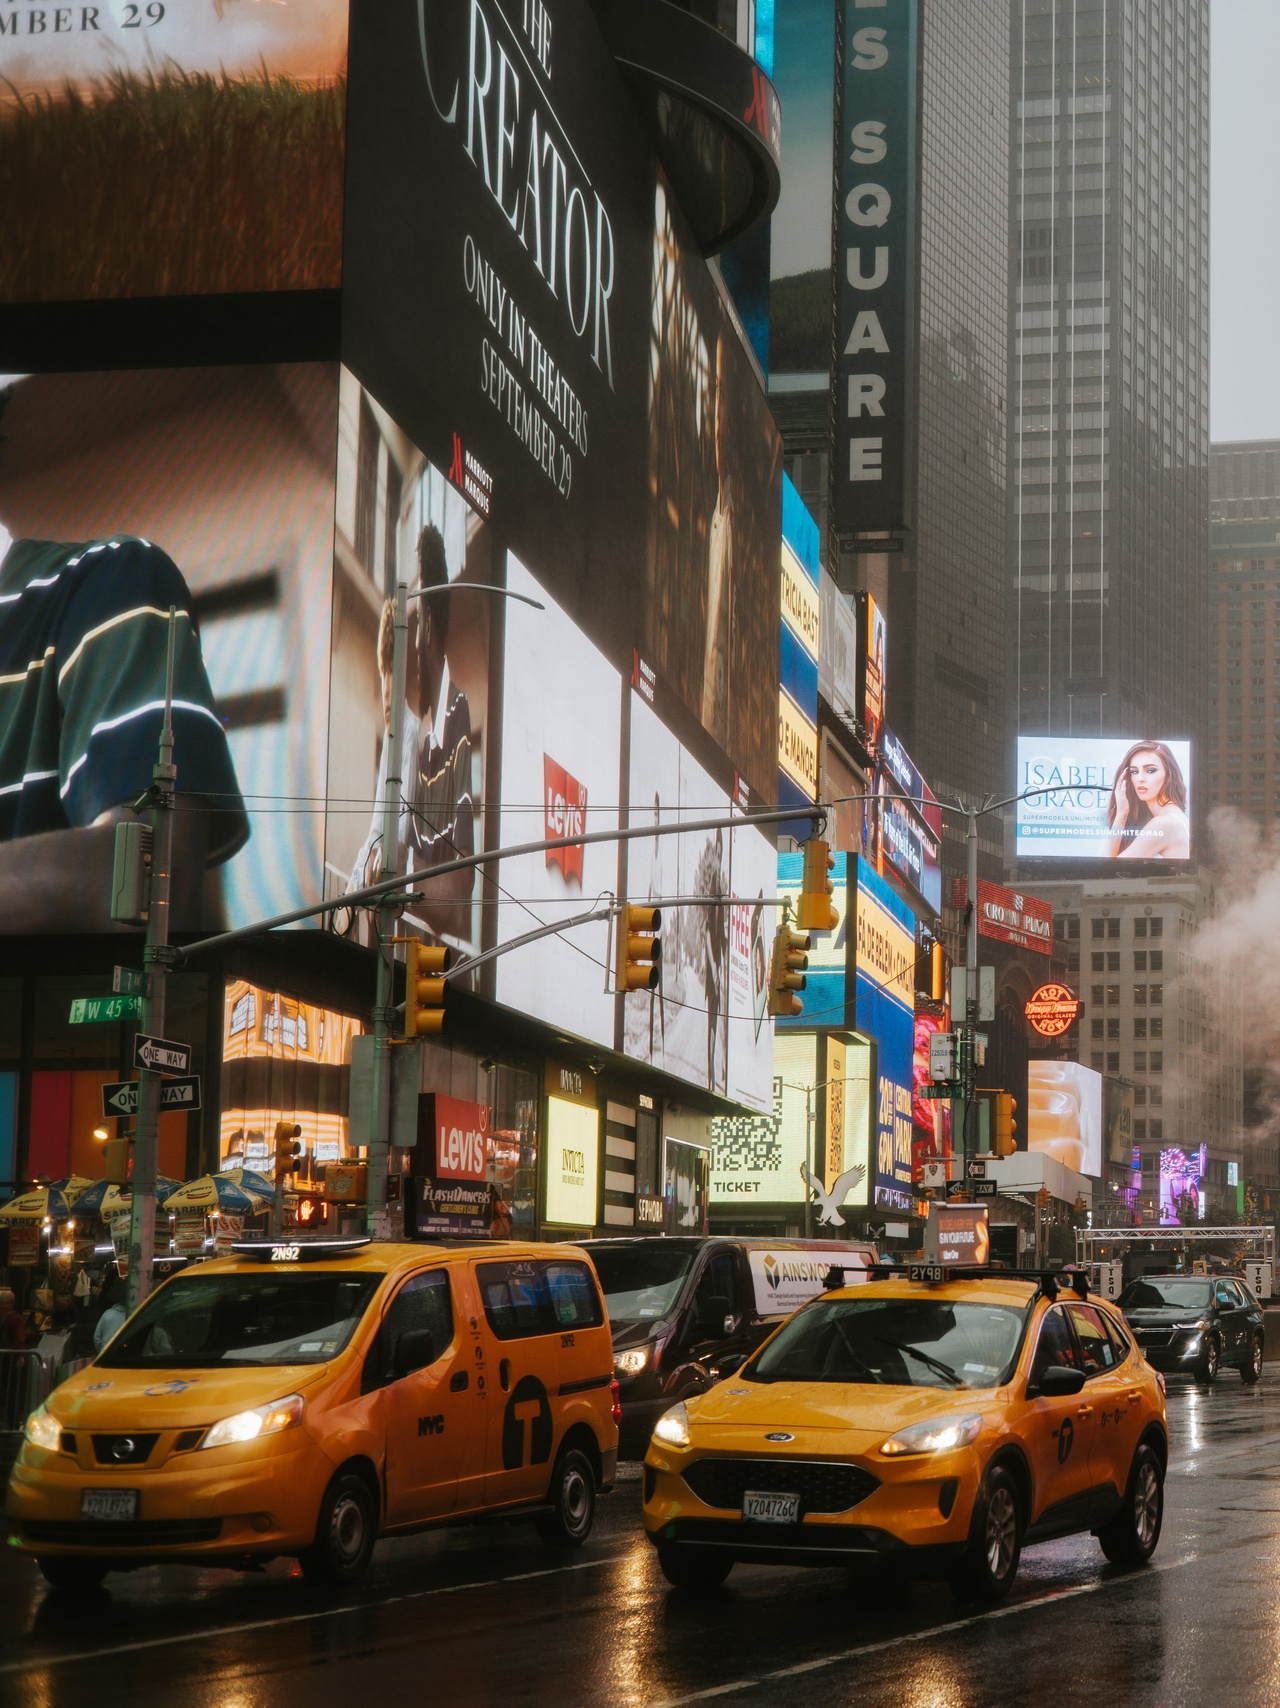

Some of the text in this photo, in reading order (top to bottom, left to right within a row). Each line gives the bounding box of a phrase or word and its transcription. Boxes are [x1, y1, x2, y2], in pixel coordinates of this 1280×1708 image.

[121, 2, 165, 28] 29
[417, 0, 616, 394] CREATOR
[845, 120, 892, 482] SQUARE
[464, 235, 588, 457] ONLY IN THEATERS
[481, 338, 572, 500] SEPTEMBER 29
[465, 450, 493, 493] MARRIOTT
[464, 474, 490, 514] MARQUIS
[1024, 761, 1114, 786] ISABEL
[1023, 785, 1108, 808] GRACE
[1031, 827, 1164, 837] @SUPERMODELSUNLIMITEDMAG
[731, 891, 749, 958] FREE
[1024, 915, 1050, 937] PLAZA
[1039, 988, 1064, 1000] HOT
[88, 998, 138, 1019] W 45 St
[1039, 1020, 1064, 1032] NOW
[143, 1046, 184, 1067] ONE WAY
[118, 1087, 188, 1107] ON WAY
[639, 1094, 653, 1109] SEPHORA
[896, 1116, 912, 1166] PARK
[562, 1148, 585, 1175] INVICTA
[177, 1185, 213, 1197] SABRETT
[714, 1182, 761, 1193] TICKET
[976, 1182, 991, 1193] WAY
[638, 1199, 664, 1223] SEPHORA
[271, 1247, 299, 1261] 2N92
[911, 1267, 942, 1280] 2Y98
[1107, 1267, 1116, 1295] TSQ
[1255, 1267, 1263, 1295] TSQ
[418, 1414, 445, 1438] NYC
[748, 1499, 795, 1517] Y204726C
